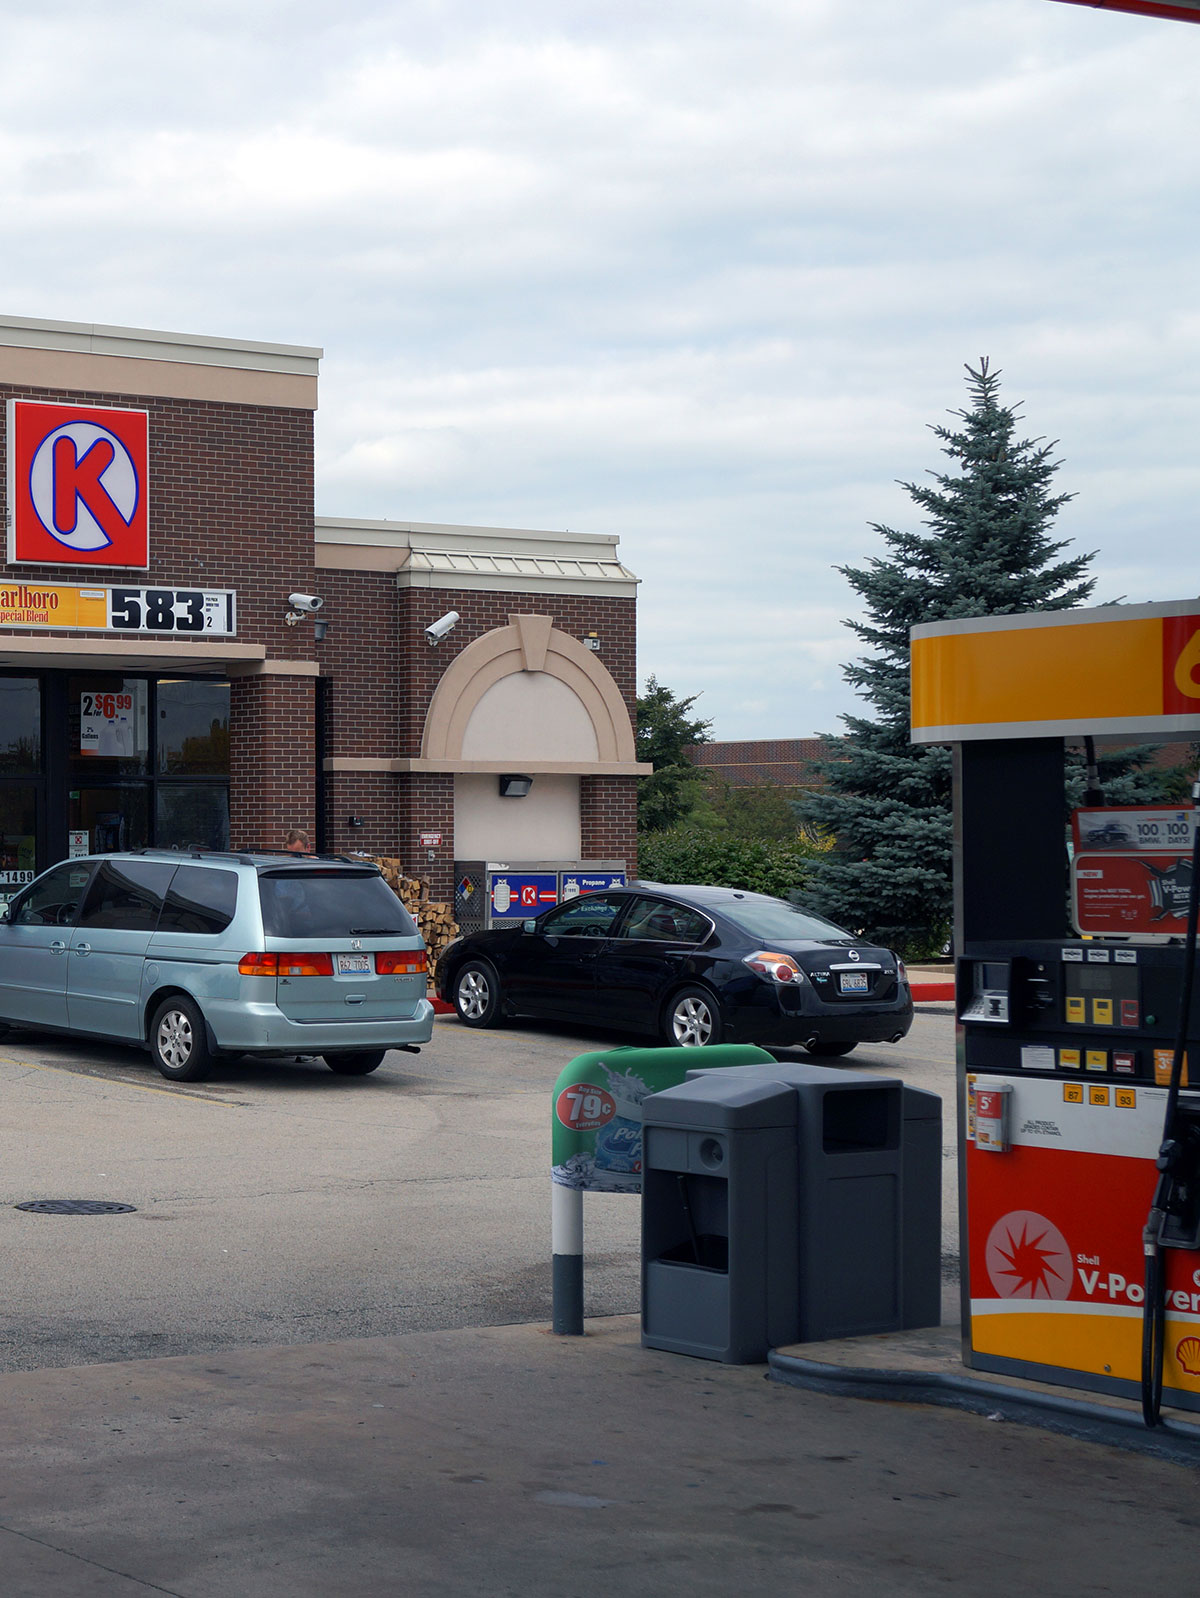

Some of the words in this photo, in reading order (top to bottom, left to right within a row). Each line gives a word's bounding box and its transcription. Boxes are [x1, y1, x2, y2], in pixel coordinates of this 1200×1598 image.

[48, 430, 133, 547] K
[26, 610, 49, 622] Blend
[112, 589, 204, 631] 5.83
[83, 695, 93, 716] 2
[1137, 824, 1159, 836] 100
[1166, 823, 1189, 835] 100
[1162, 886, 1190, 894] V-Pow
[1068, 1091, 1079, 1100] 87
[1094, 1094, 1106, 1103] 89
[1120, 1096, 1132, 1106] 93
[614, 1127, 642, 1140] Pol
[1076, 1254, 1100, 1266] Shell
